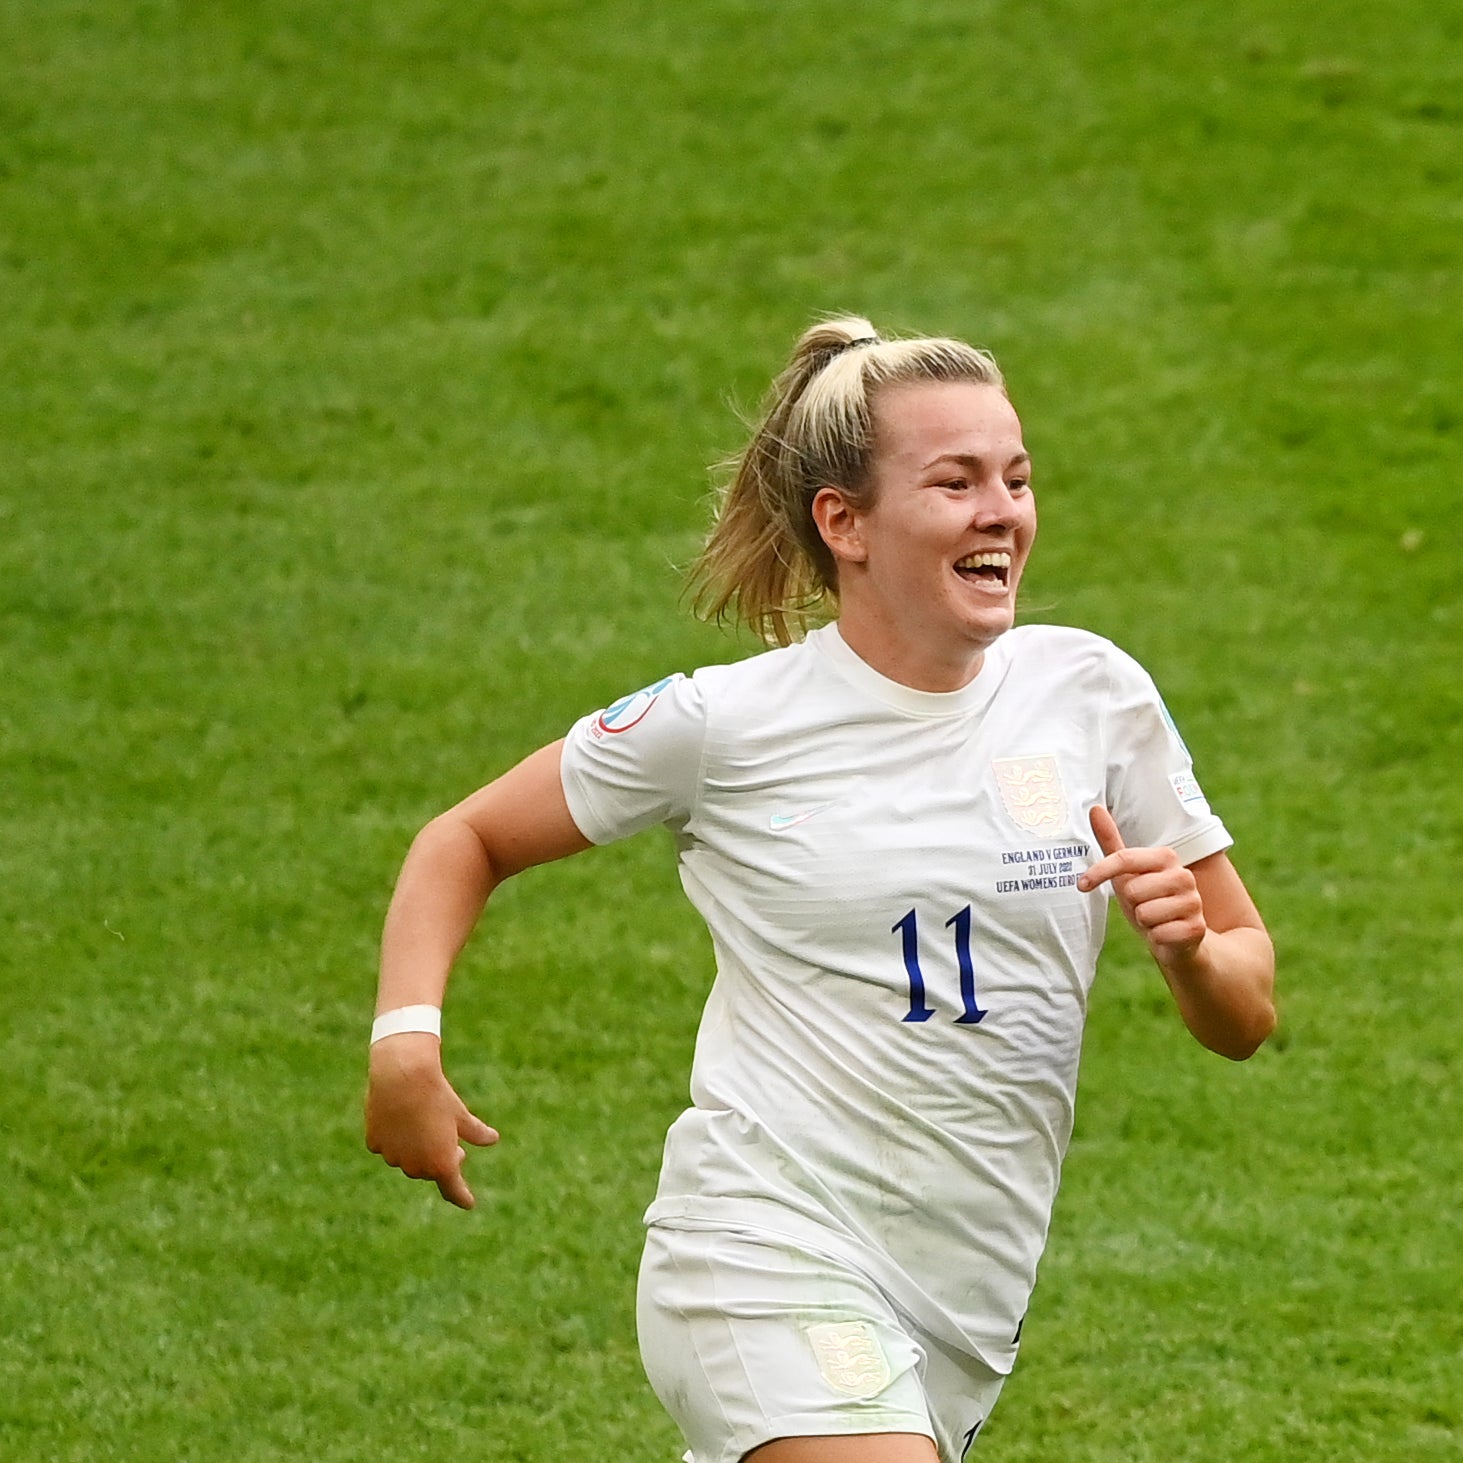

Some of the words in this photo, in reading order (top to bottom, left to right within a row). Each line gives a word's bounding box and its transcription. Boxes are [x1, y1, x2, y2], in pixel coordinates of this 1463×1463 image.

[1002, 850, 1045, 865] ENGLAND
[1046, 849, 1052, 860] V
[1053, 845, 1091, 860] GERMANY
[1038, 862, 1058, 876] JULY
[996, 880, 1020, 893] UEFA
[1021, 876, 1058, 891] WOMENS
[1058, 874, 1075, 888] EURO
[891, 903, 989, 1024] 11
